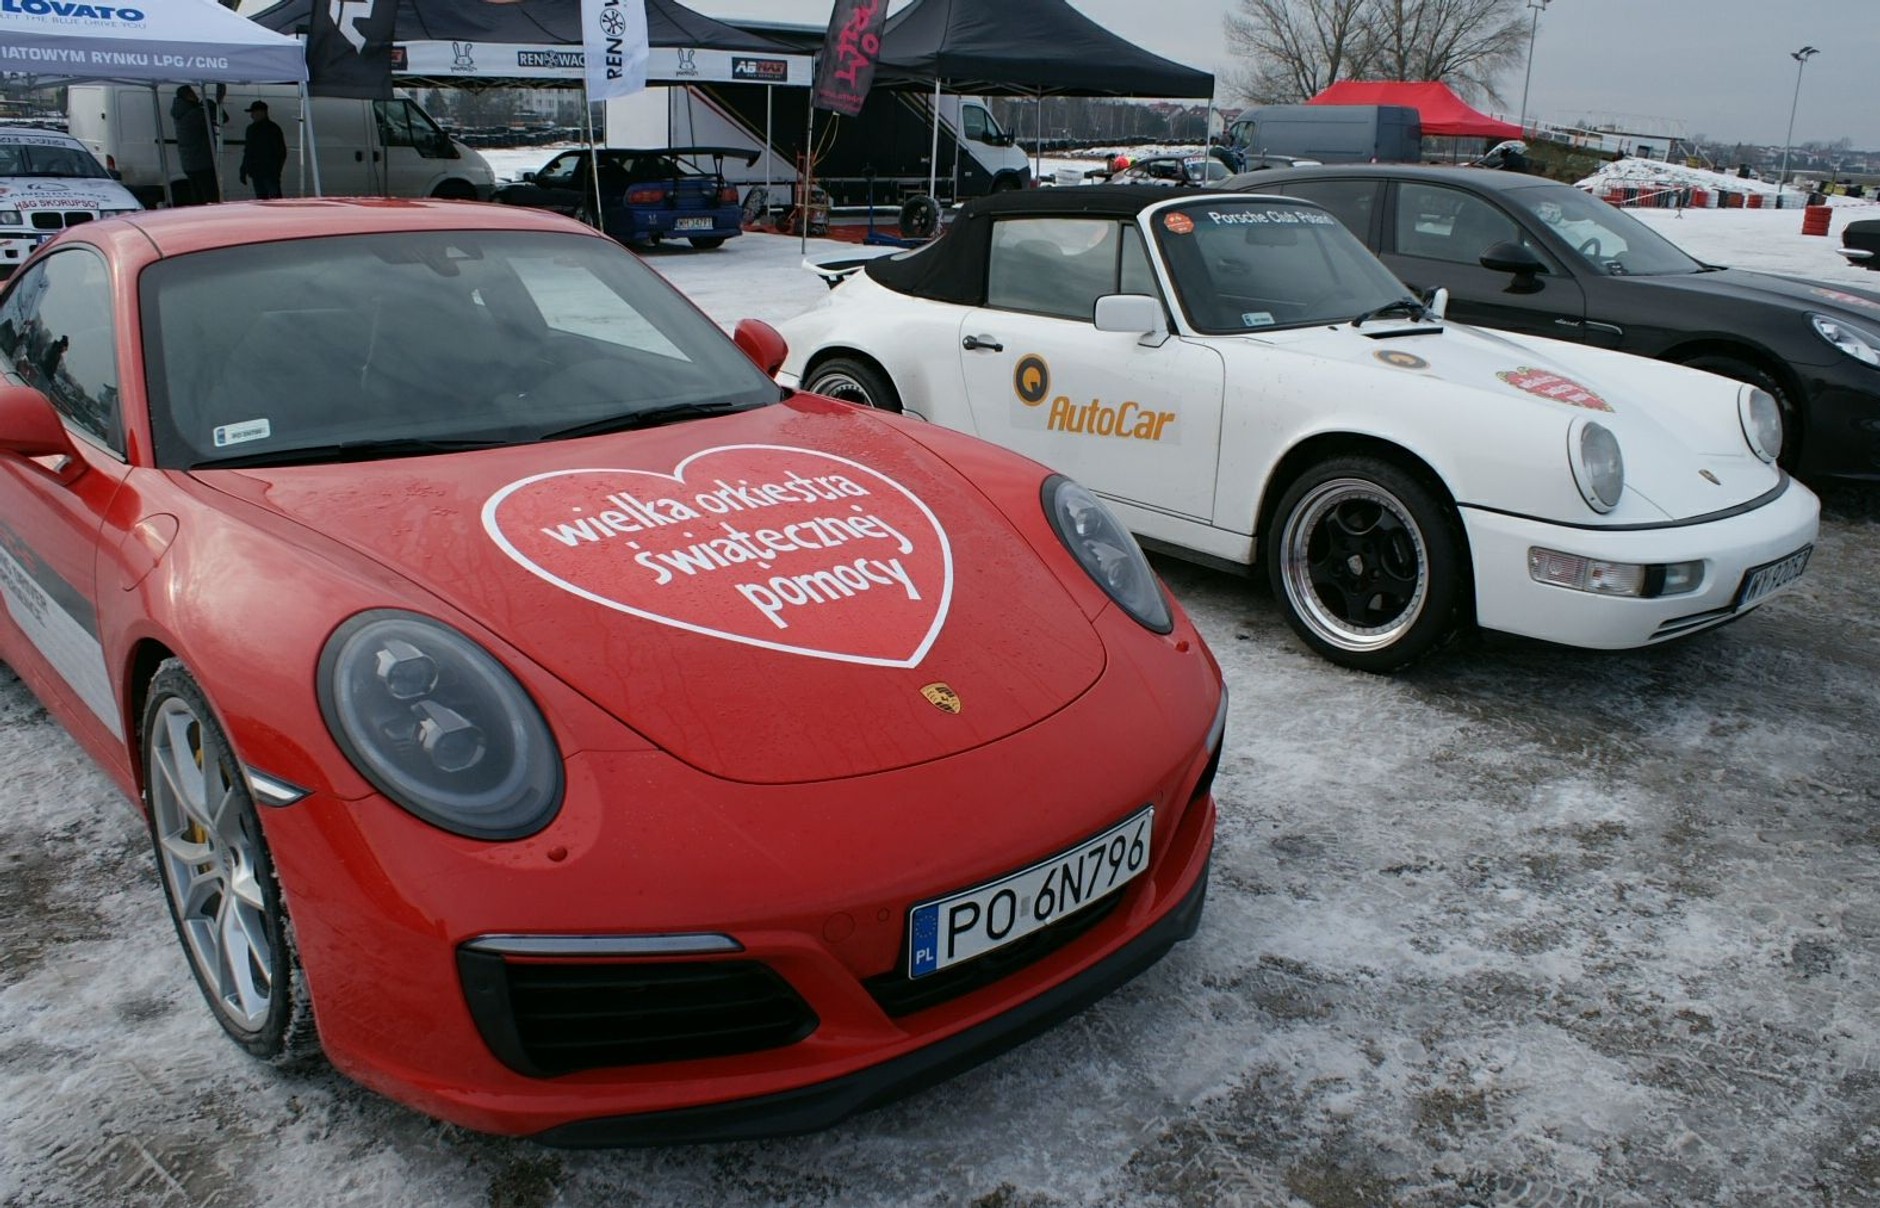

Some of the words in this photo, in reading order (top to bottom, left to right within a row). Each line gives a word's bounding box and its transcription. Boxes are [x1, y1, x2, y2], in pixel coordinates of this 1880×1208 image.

[2, 0, 145, 21] LOVATO
[91, 51, 148, 66] RYNKU
[153, 54, 228, 69] LPG/CNG
[14, 201, 37, 211] H&G
[1208, 210, 1269, 224] Porsche
[1266, 210, 1299, 223] Club
[1047, 396, 1175, 440] AutoCar
[541, 492, 700, 547] wielka
[695, 470, 870, 514] orkiestra
[628, 504, 913, 586] świątecznej
[734, 556, 922, 629] pomocy
[948, 888, 1016, 960] PO
[1033, 819, 1146, 922] 6N796
[916, 947, 934, 965] PL
